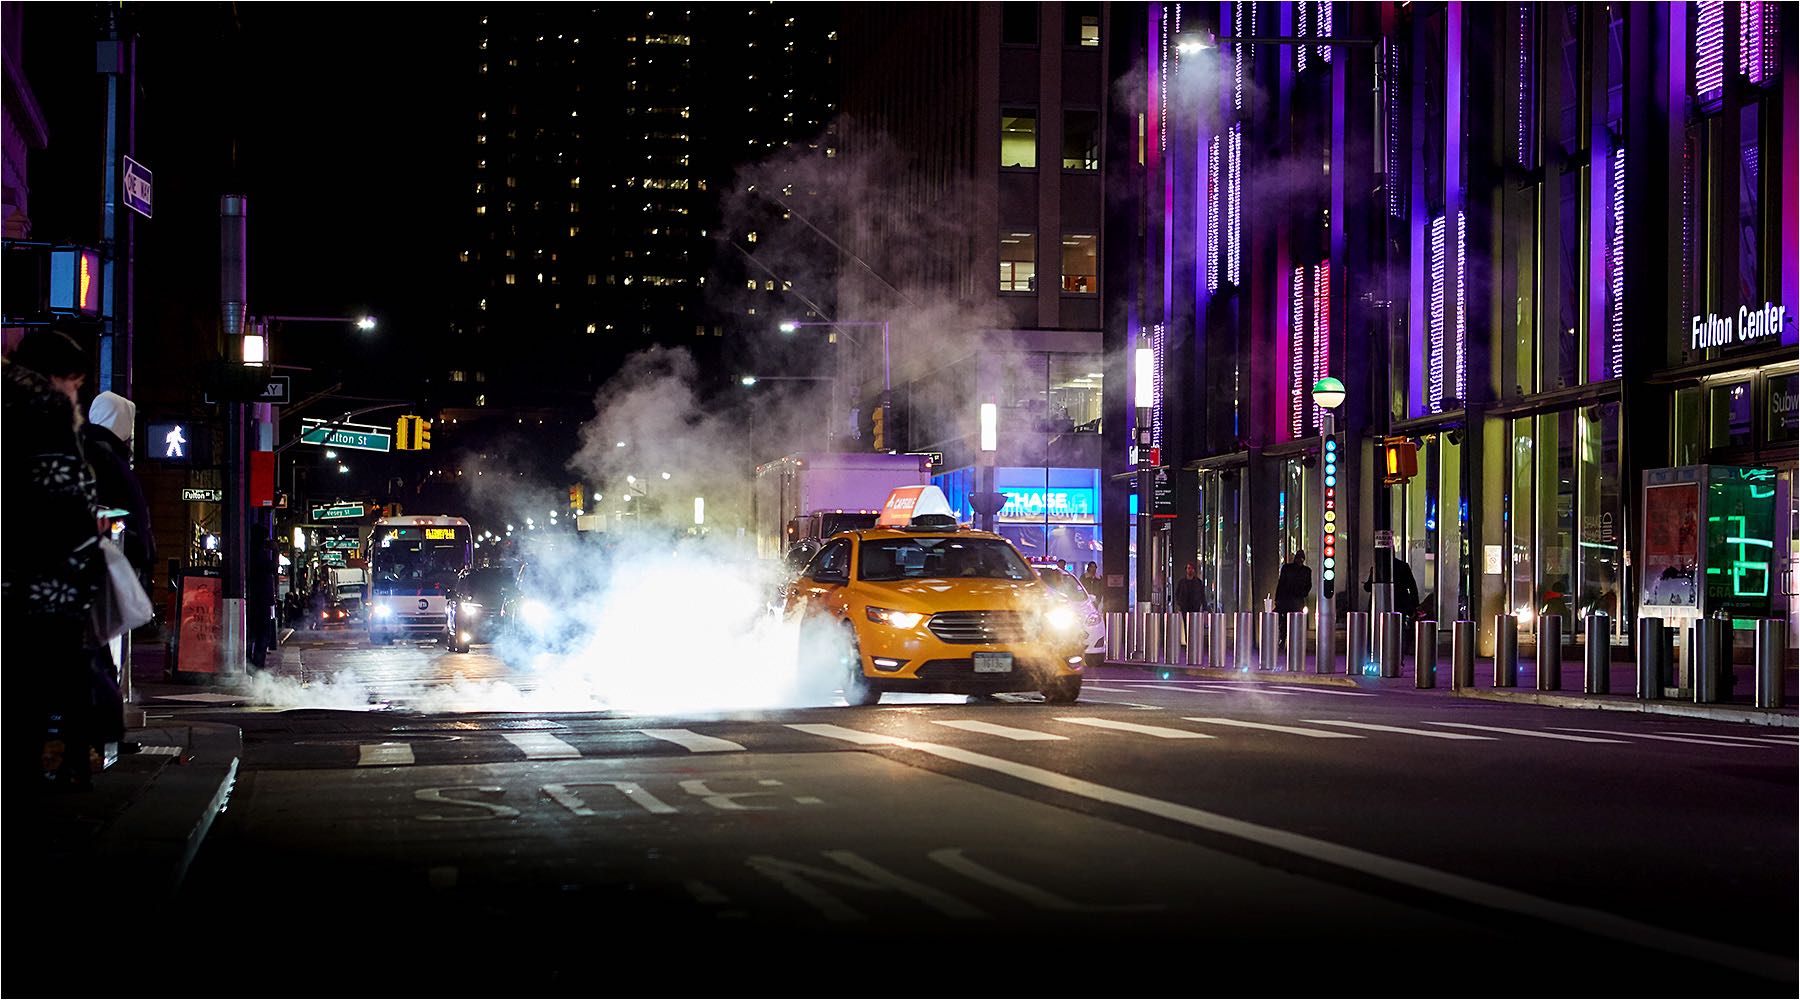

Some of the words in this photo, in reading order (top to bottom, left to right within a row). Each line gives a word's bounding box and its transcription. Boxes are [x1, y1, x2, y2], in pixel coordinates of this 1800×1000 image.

[128, 174, 137, 194] ONE
[141, 181, 150, 203] WAY
[1692, 312, 1733, 350] Fulton
[1738, 301, 1785, 341] Center
[358, 435, 367, 445] St
